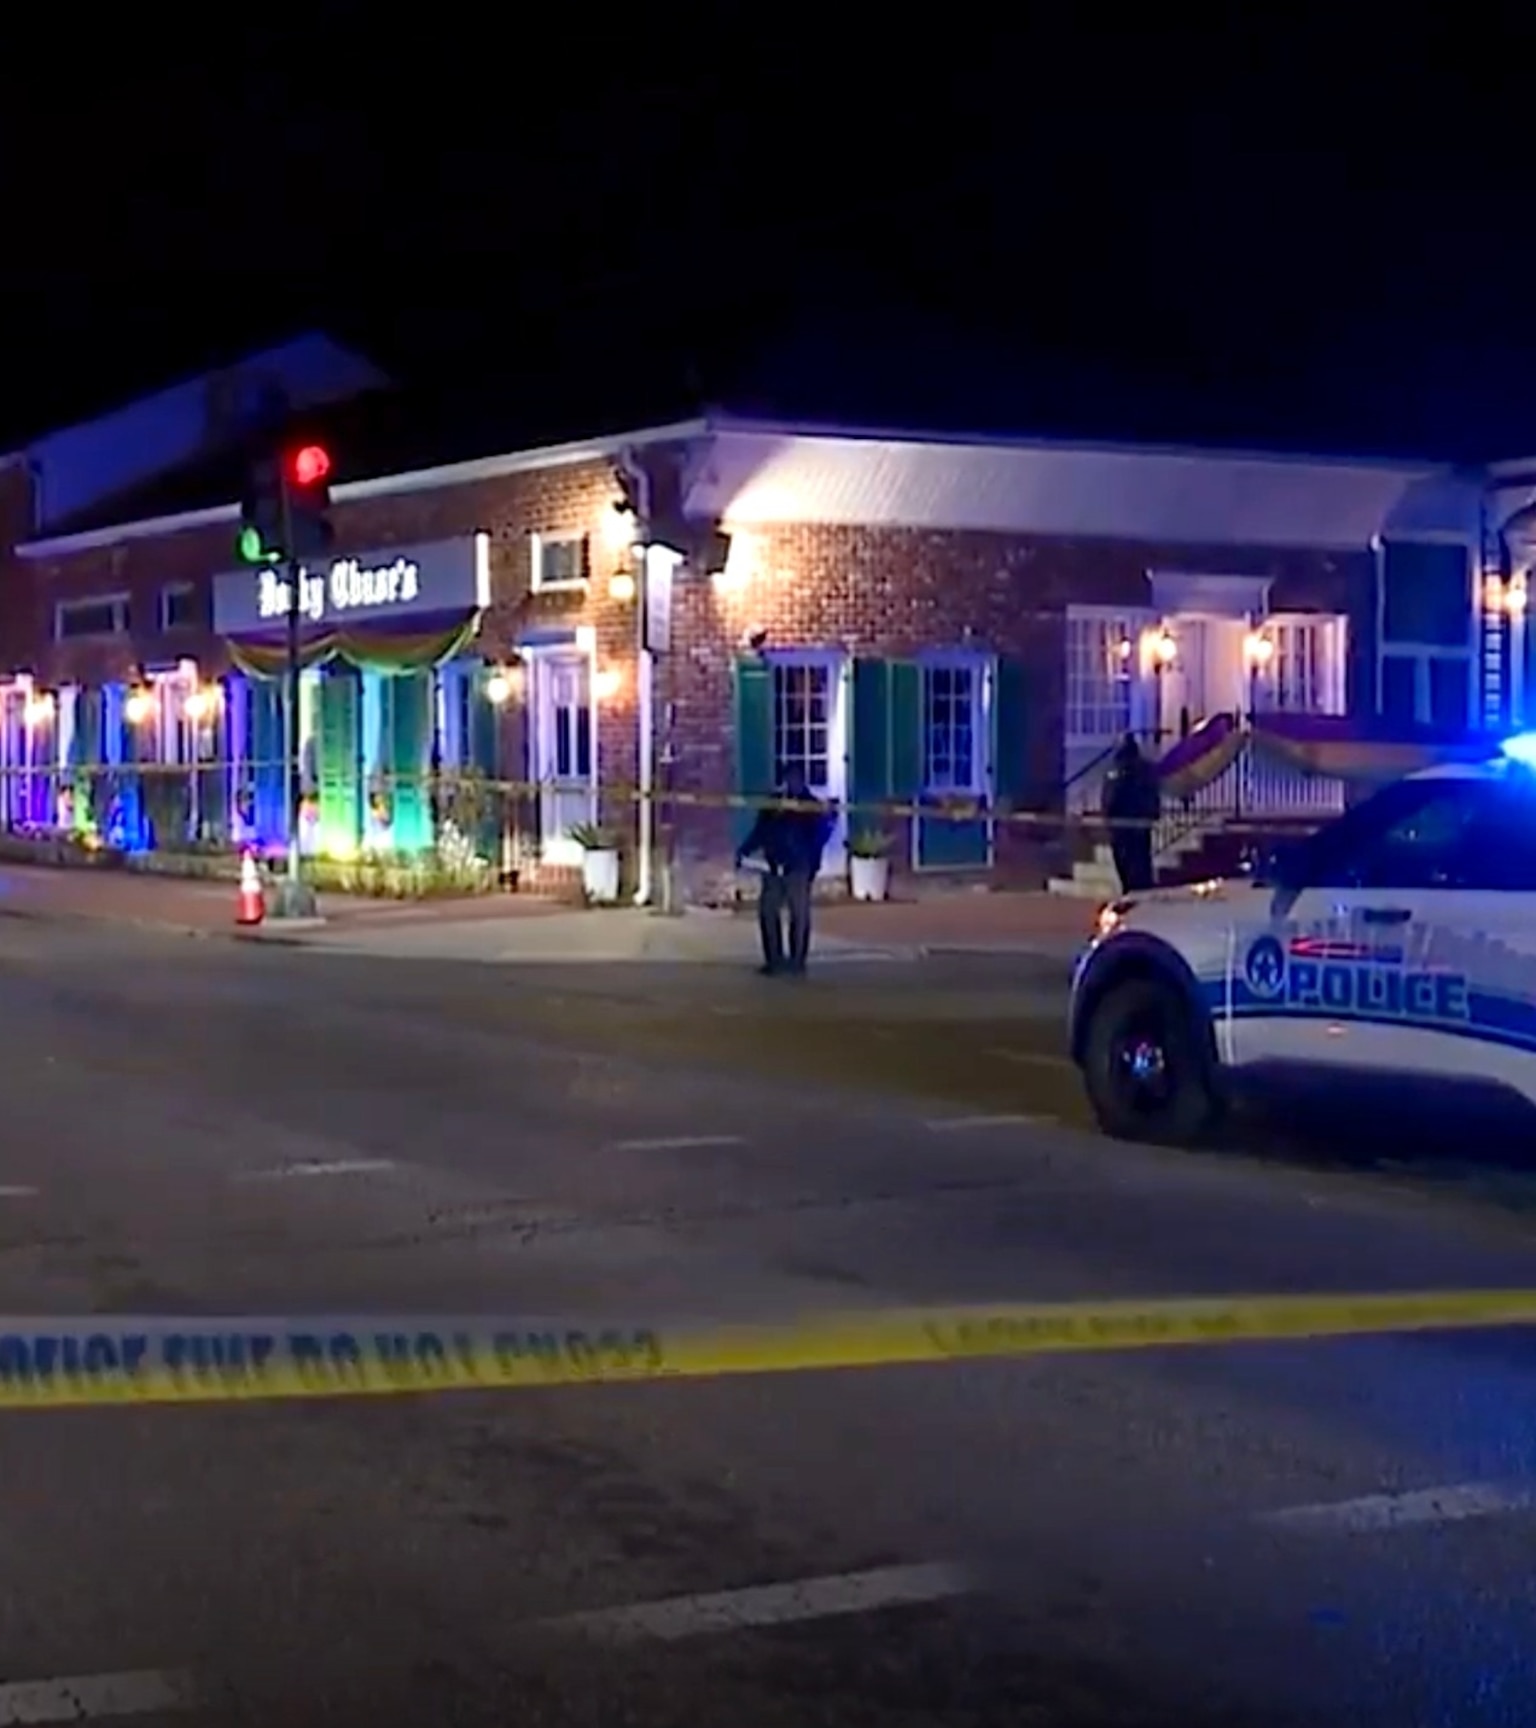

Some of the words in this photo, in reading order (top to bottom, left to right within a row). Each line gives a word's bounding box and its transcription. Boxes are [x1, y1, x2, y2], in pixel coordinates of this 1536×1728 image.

[259, 569, 325, 621] Doky
[330, 558, 418, 610] Chase's
[1286, 962, 1469, 1020] POLICE
